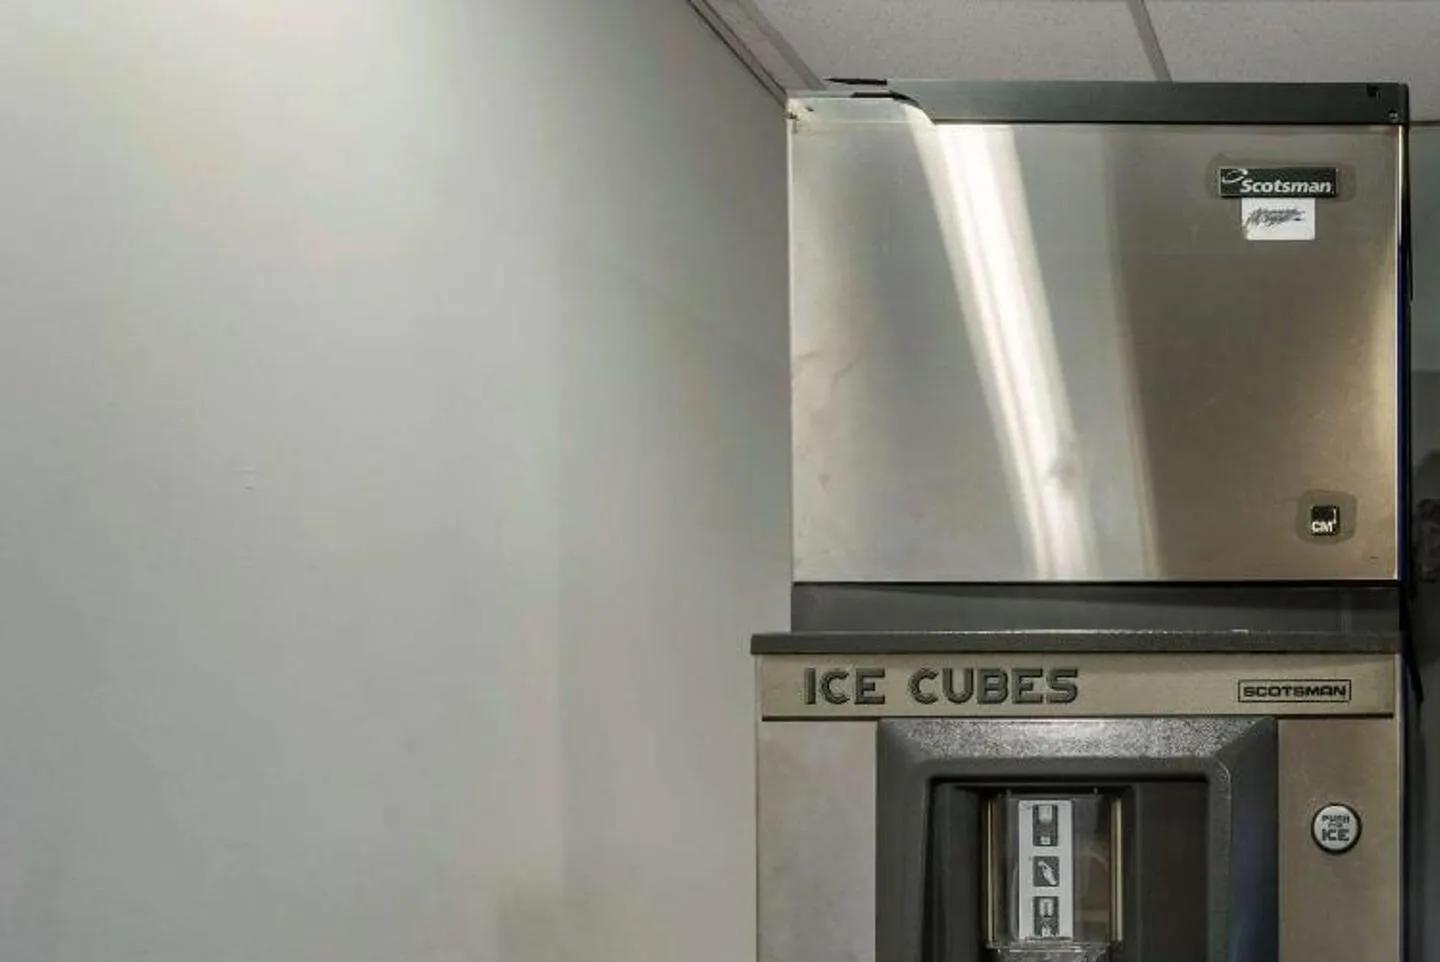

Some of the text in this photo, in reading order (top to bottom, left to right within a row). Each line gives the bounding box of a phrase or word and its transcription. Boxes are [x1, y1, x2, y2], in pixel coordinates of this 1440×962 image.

[1239, 178, 1332, 194] Scotsman
[803, 667, 1078, 705] ICE CUBES
[1243, 685, 1346, 697] SCOTSMAN
[1321, 828, 1350, 841] ICE
